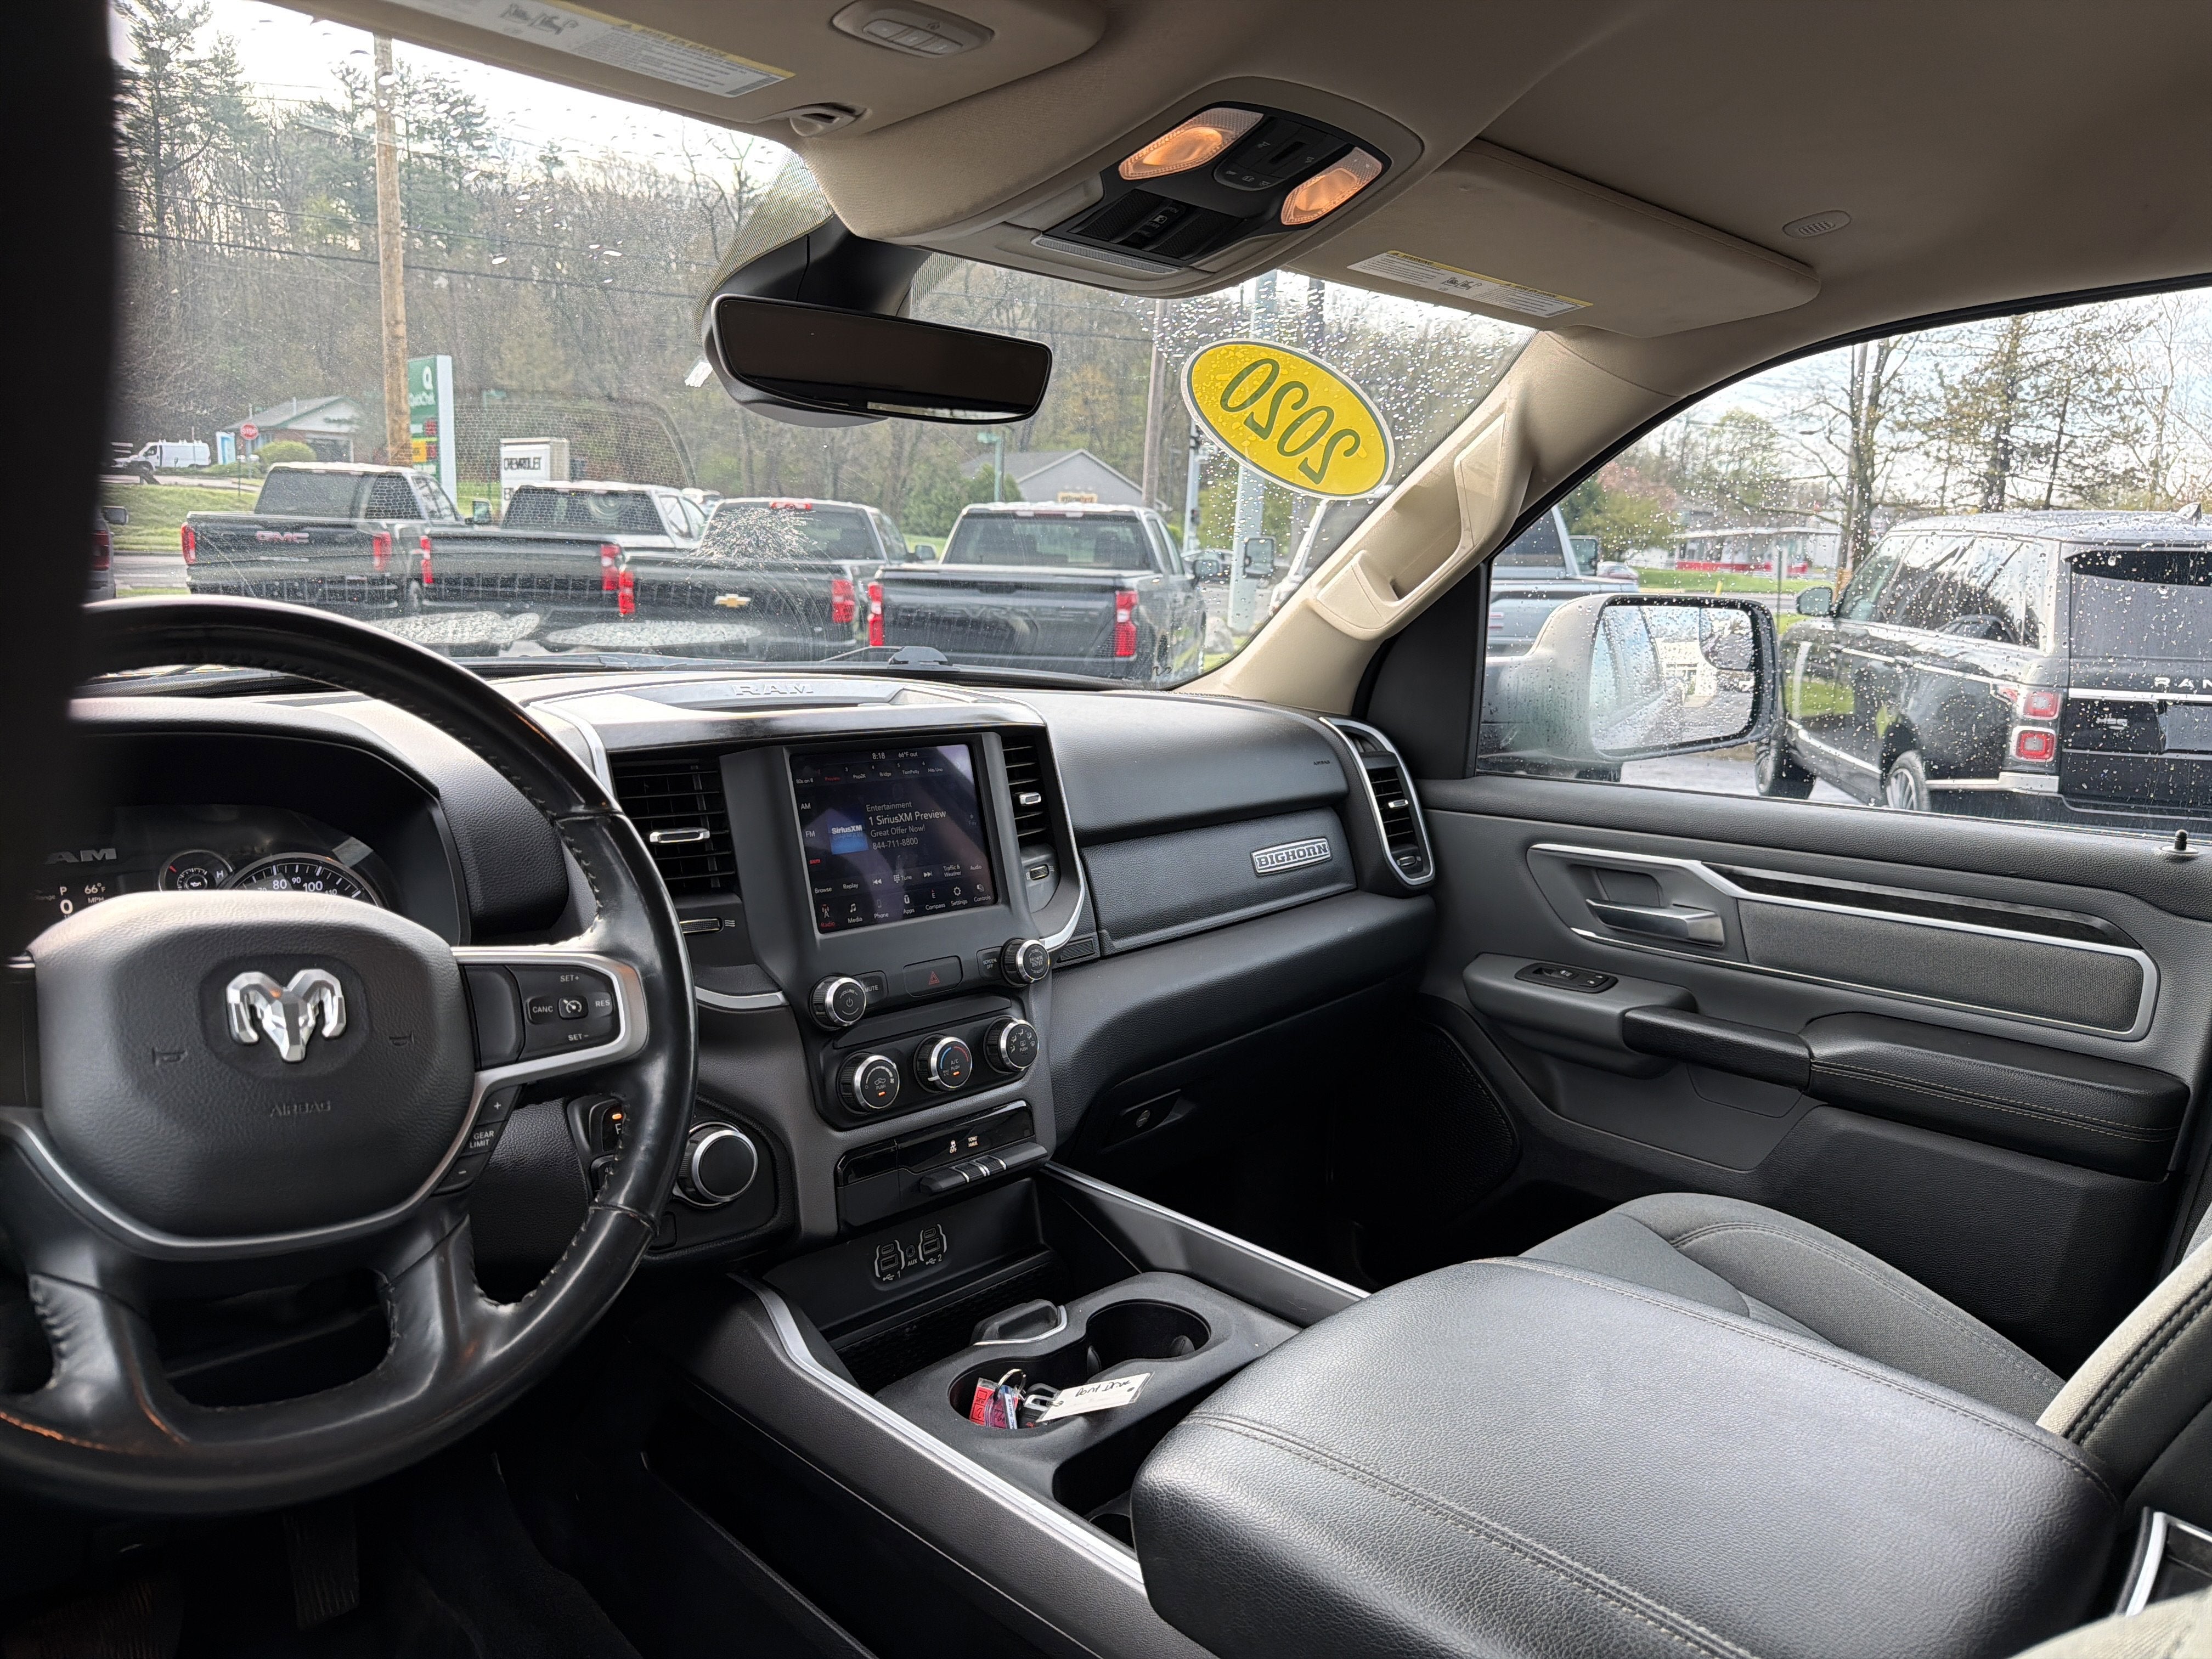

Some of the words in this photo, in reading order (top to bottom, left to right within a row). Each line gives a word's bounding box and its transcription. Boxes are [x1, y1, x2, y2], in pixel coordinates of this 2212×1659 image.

[422, 366, 433, 390] Q
[241, 427, 258, 436] STOP
[256, 531, 309, 542] GMC
[732, 684, 814, 696] RAM
[866, 801, 912, 812] Entertainment
[868, 816, 874, 826] 1
[876, 812, 913, 826] SiriusXM
[915, 809, 947, 821] Preview
[805, 830, 816, 838] FM
[831, 825, 863, 834] SiriusXM
[870, 828, 889, 838] Great
[890, 826, 907, 835] Offer
[909, 824, 926, 832] Now!
[872, 837, 919, 850] 844-711-8800
[45, 848, 117, 865] AM
[1257, 842, 1328, 869] BIGHORN
[216, 870, 224, 878] H
[272, 878, 287, 890] 80
[302, 880, 323, 892] 100
[59, 886, 67, 896] P
[973, 894, 992, 903] Controls
[60, 899, 74, 915] 0
[925, 902, 946, 911] Compass
[532, 1005, 554, 1013] CANC
[269, 1100, 331, 1118] AIRBAG
[473, 1130, 494, 1140] GEAR
[469, 1139, 490, 1149] LIMIT
[907, 1258, 918, 1267] AUX
[938, 1254, 943, 1262] 2
[896, 1270, 901, 1278] 1
